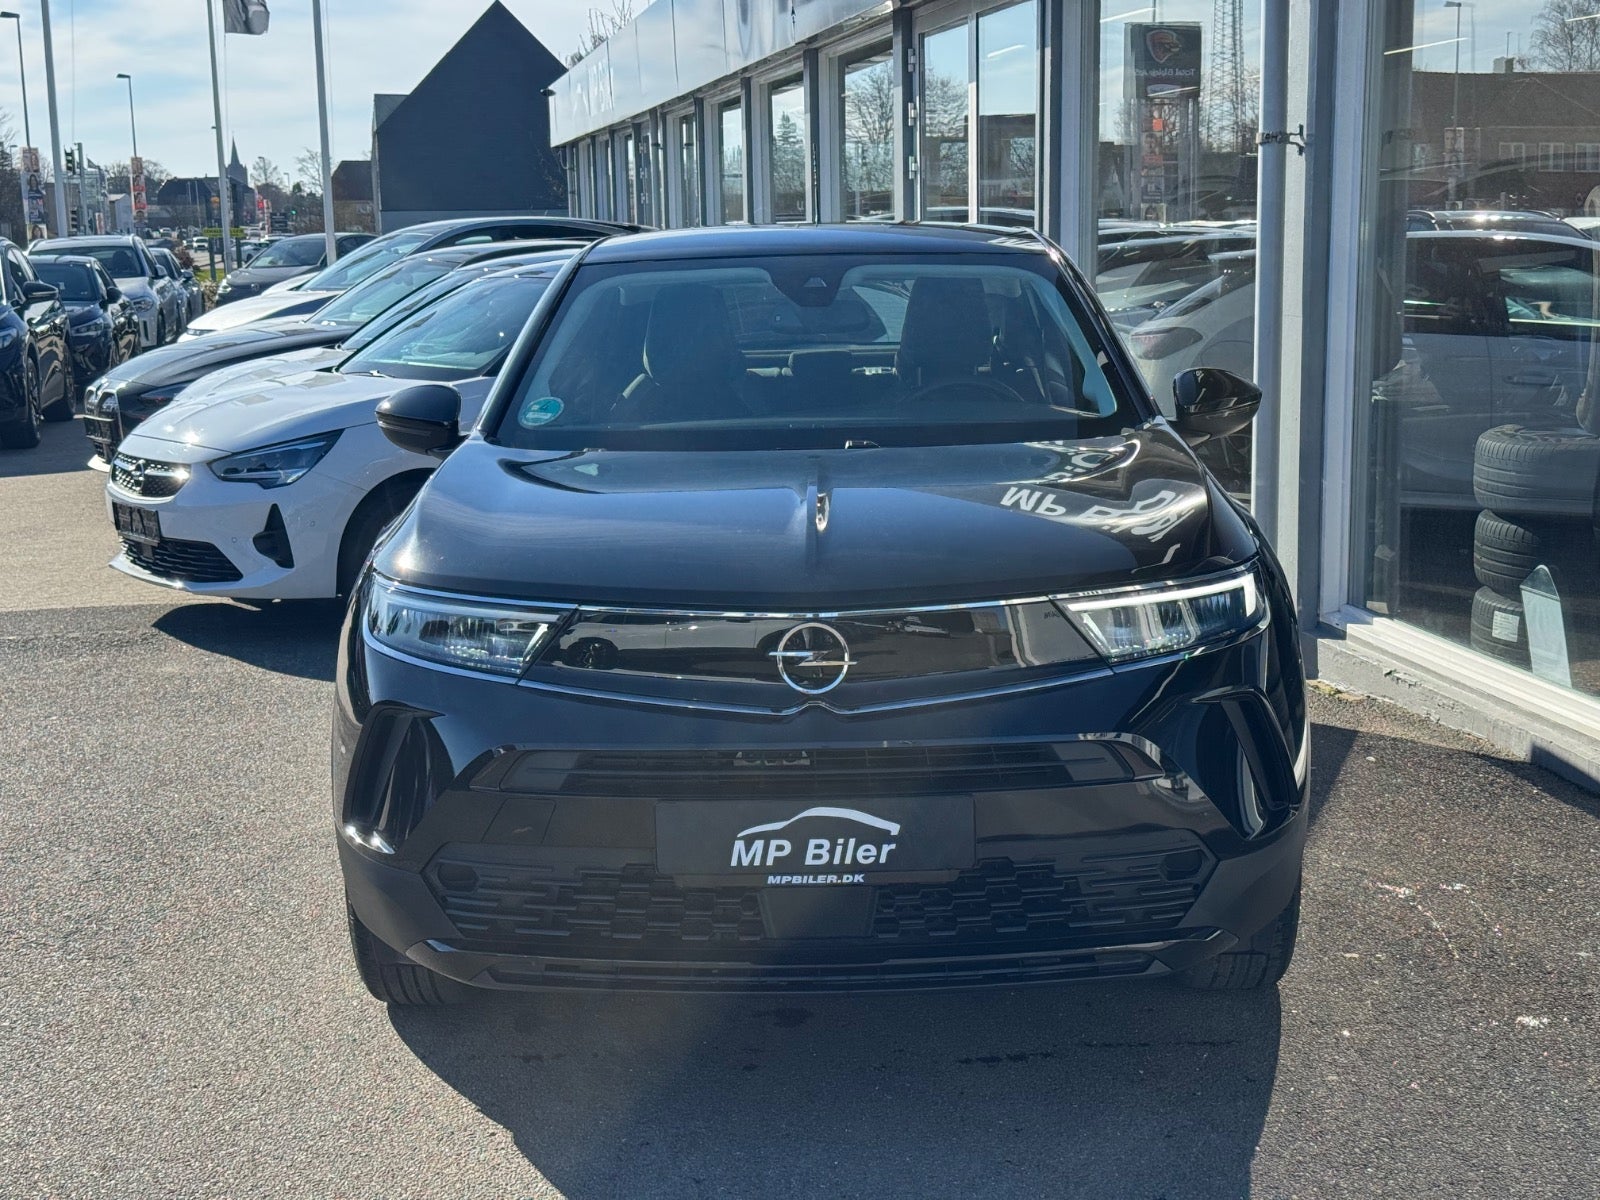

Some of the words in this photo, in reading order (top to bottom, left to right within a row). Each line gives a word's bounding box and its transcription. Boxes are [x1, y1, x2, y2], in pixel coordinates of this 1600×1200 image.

[730, 839, 792, 867] MP
[804, 837, 897, 866] Biler
[767, 873, 865, 885] MPBILER.DK
